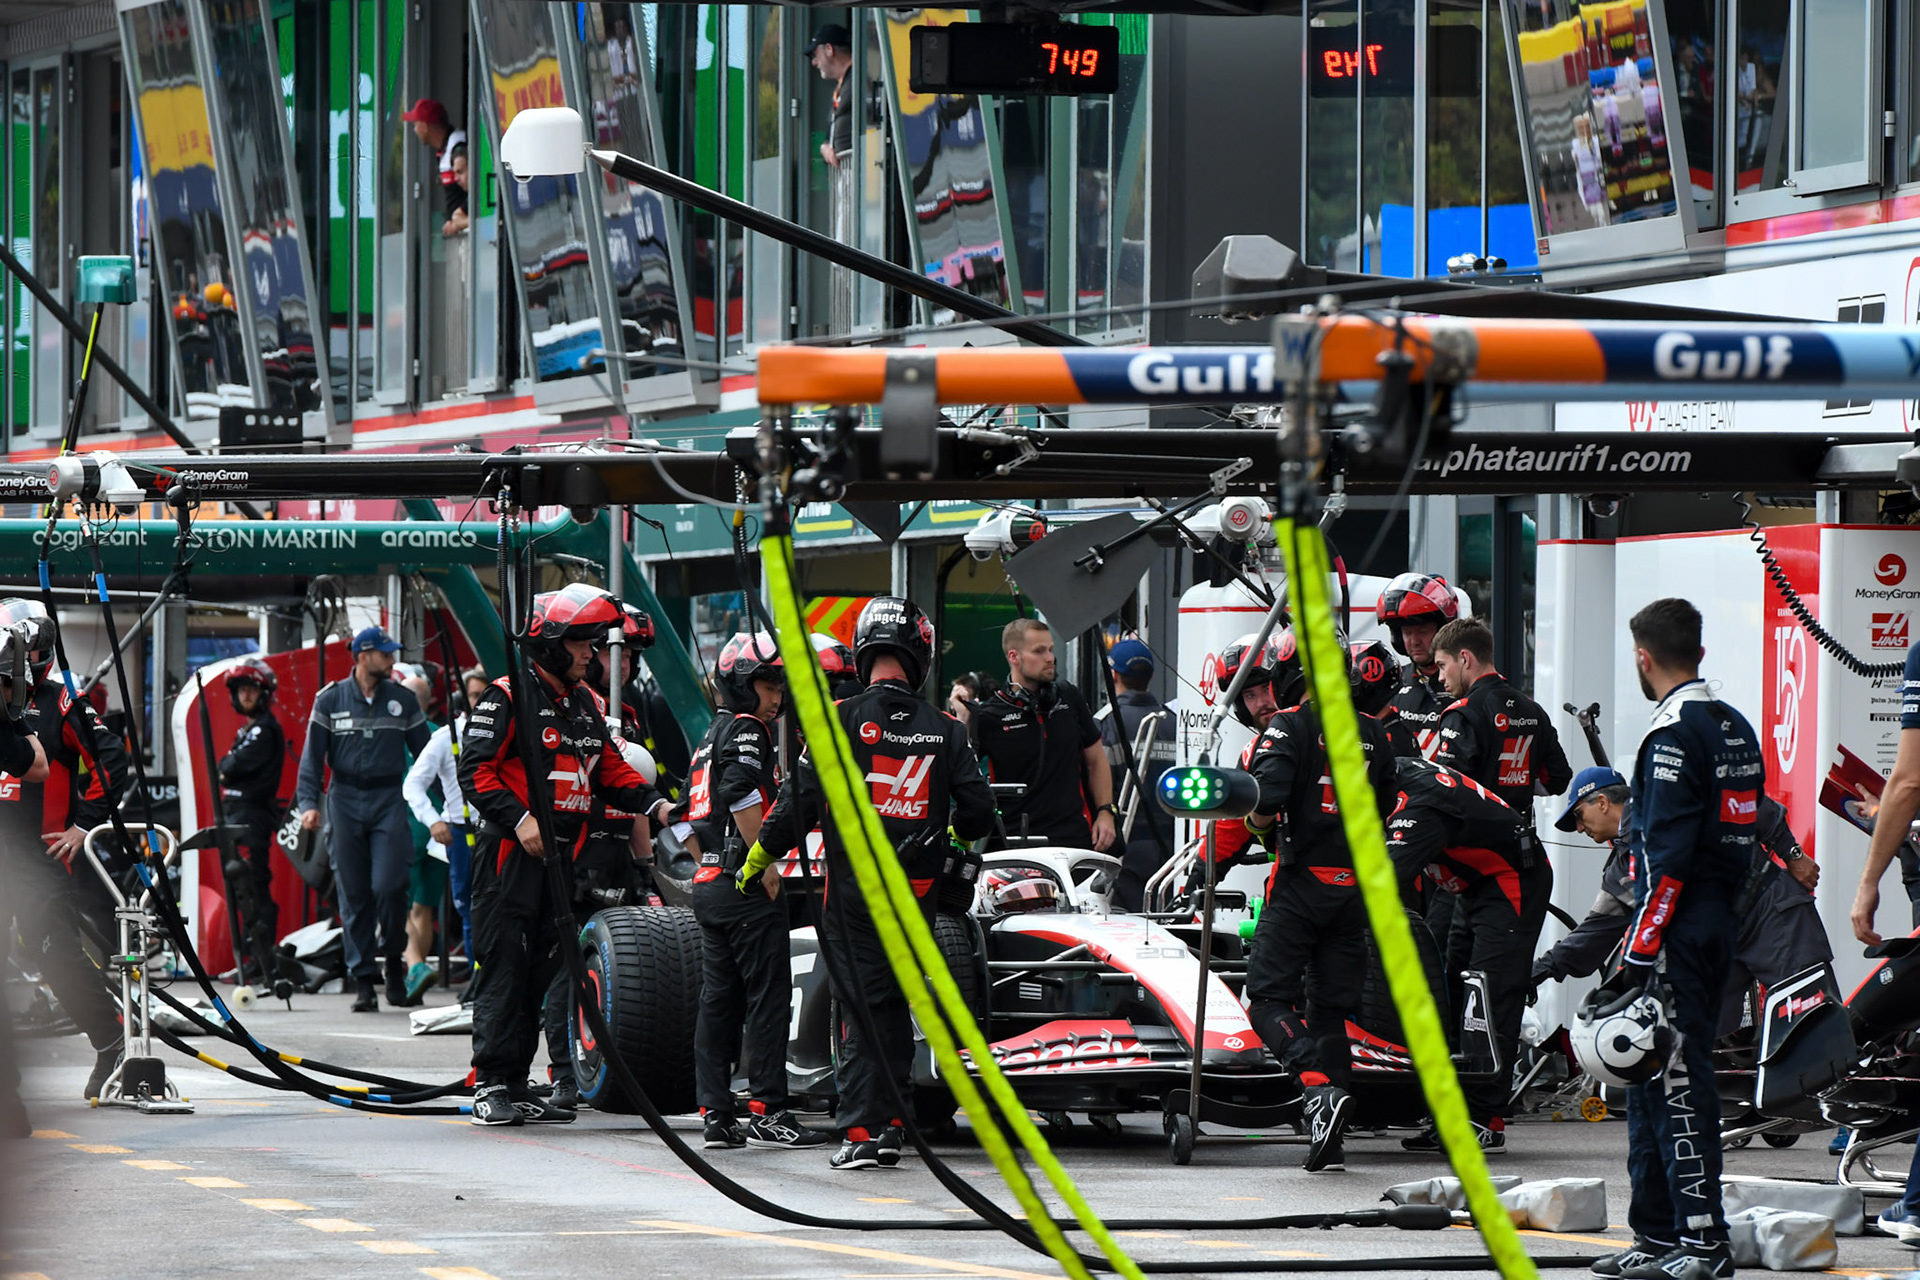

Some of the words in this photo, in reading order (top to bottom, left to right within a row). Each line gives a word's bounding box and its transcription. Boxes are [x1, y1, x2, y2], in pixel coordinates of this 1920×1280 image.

[1653, 331, 1793, 379] Gulf
[0, 475, 47, 489] oneyGra
[262, 528, 357, 549] MARTIN
[380, 530, 478, 548] aramco
[865, 611, 908, 626] Angels
[1400, 709, 1442, 724] MoneyGr
[733, 733, 761, 743] HAAS
[882, 730, 944, 746] MoneyGram
[1498, 770, 1530, 784] HAAS
[872, 797, 929, 817] HAAS
[1652, 886, 1676, 926] ORLEN
